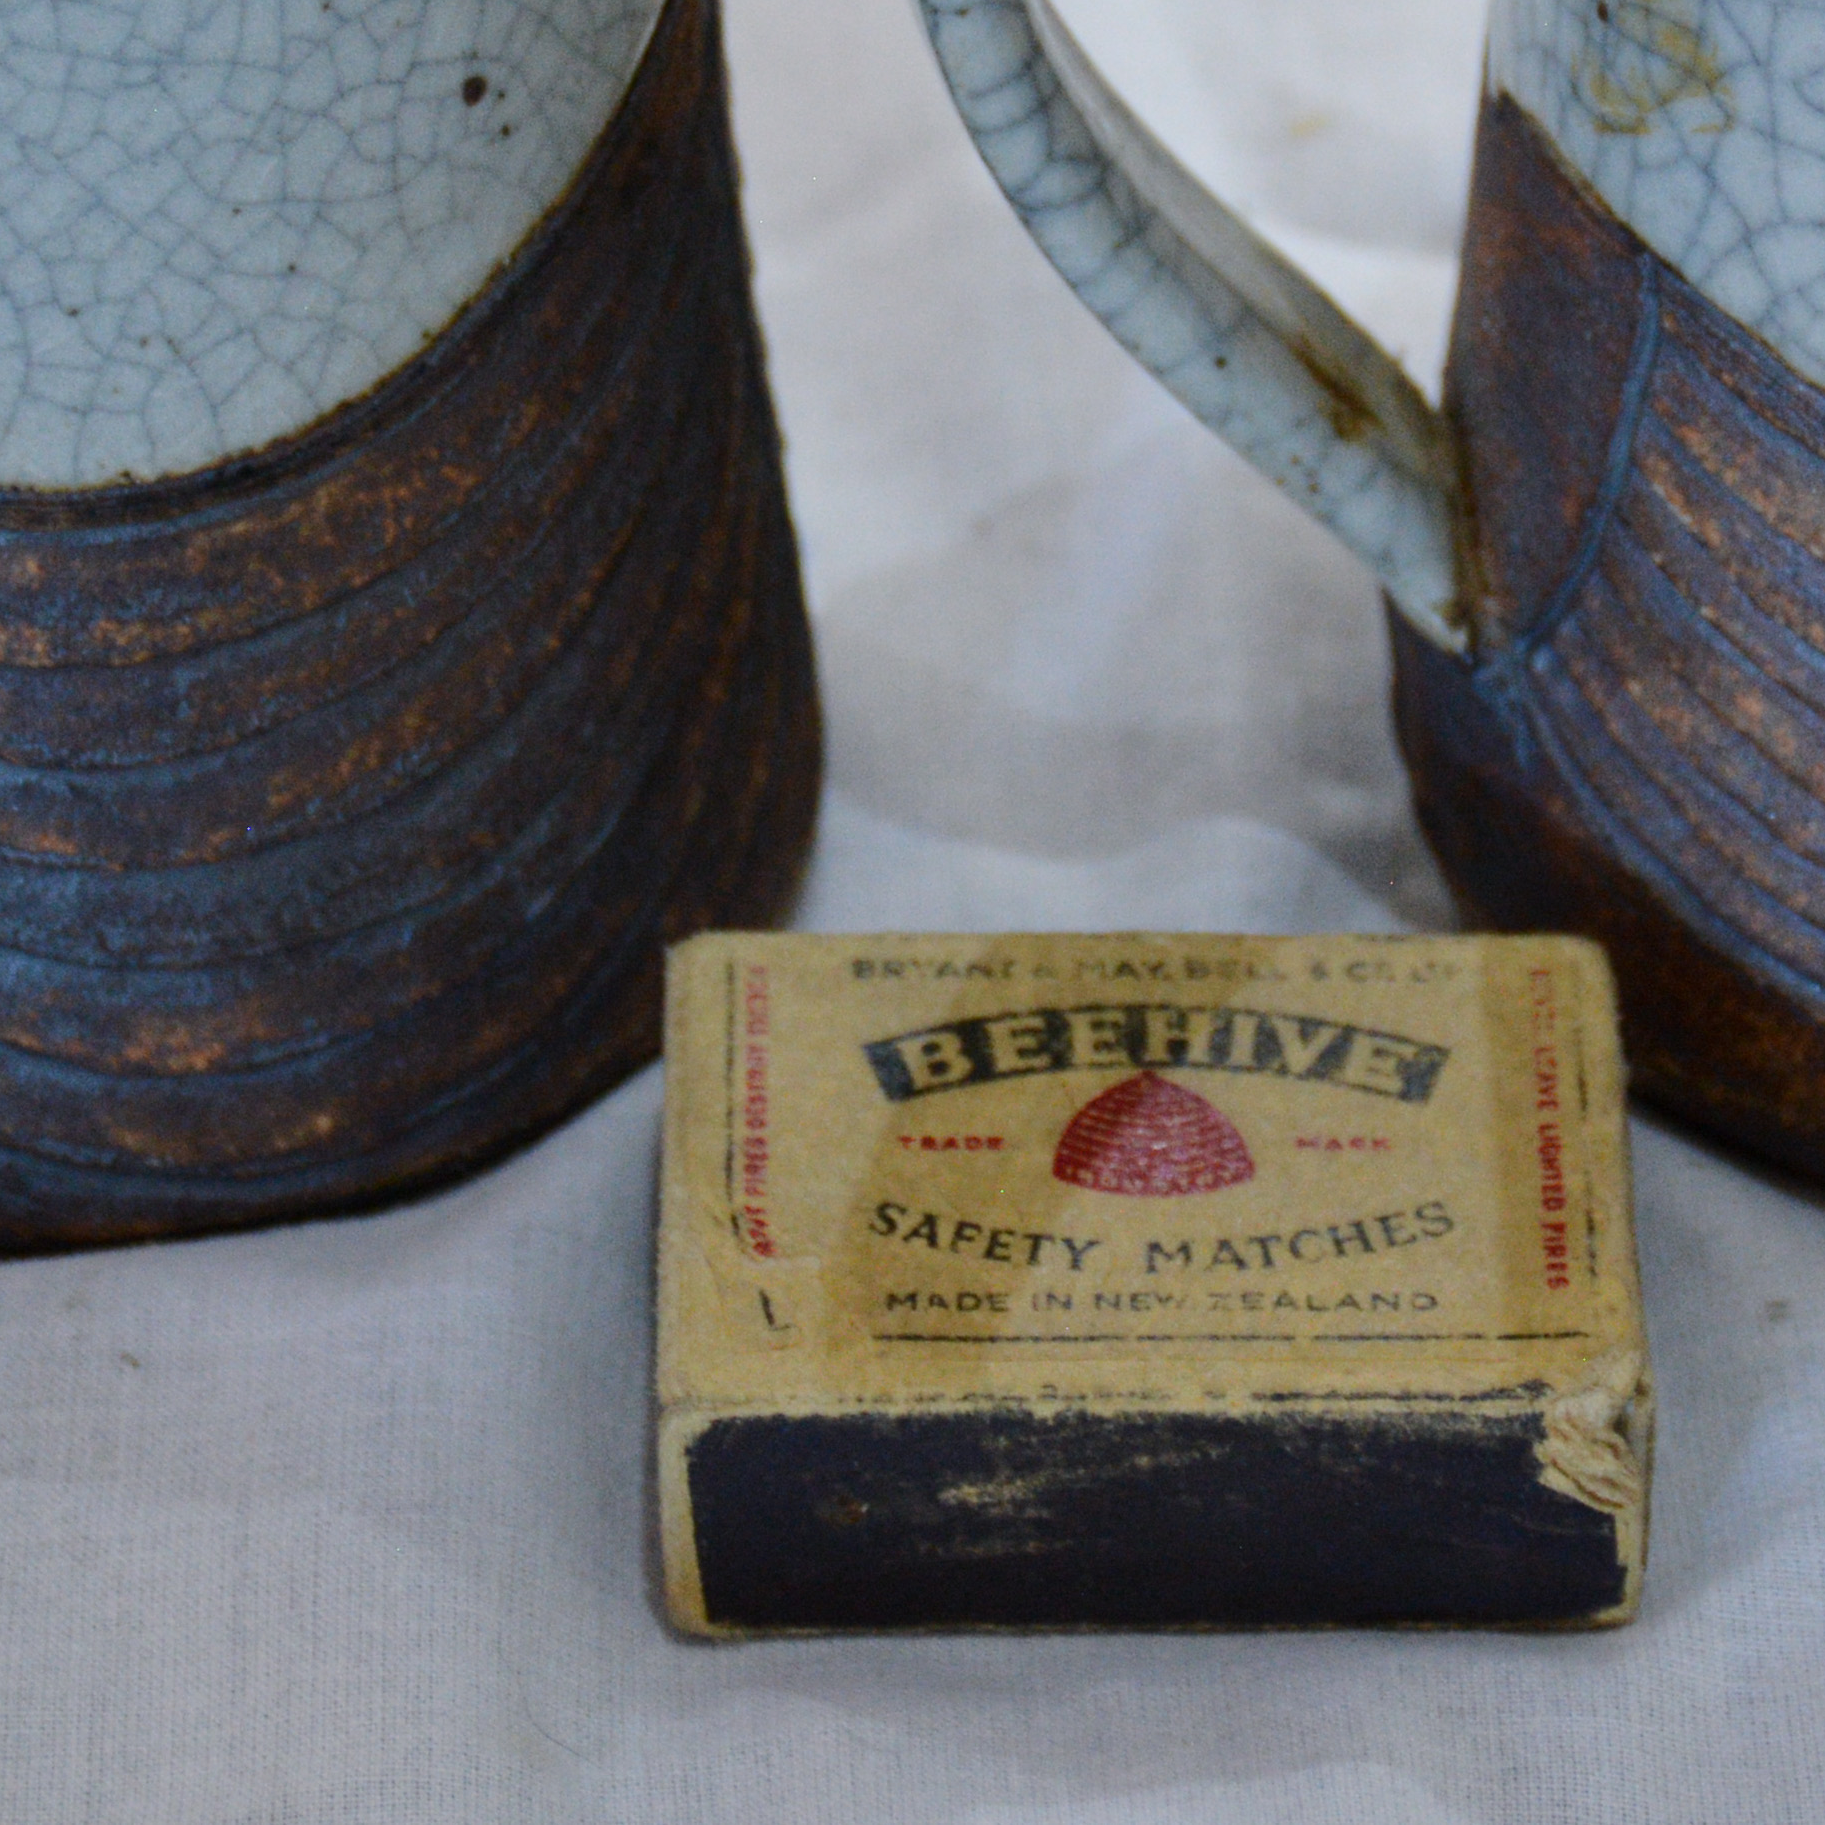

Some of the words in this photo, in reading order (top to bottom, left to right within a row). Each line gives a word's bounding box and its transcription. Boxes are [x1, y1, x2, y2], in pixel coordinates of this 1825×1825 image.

[893, 1009, 1419, 1096] BEEHIVE
[898, 1135, 1005, 1151] TRADE
[1537, 1123, 1567, 1211] LIGHTED
[868, 1200, 1103, 1272] SAFETY
[1144, 1199, 1456, 1274] MATCHES
[1541, 1221, 1571, 1291] FIRES
[884, 1290, 1009, 1313] MADE
[1032, 1290, 1075, 1313] IN
[1093, 1290, 1185, 1313] NEW
[1208, 1290, 1439, 1313] ZEALAND
